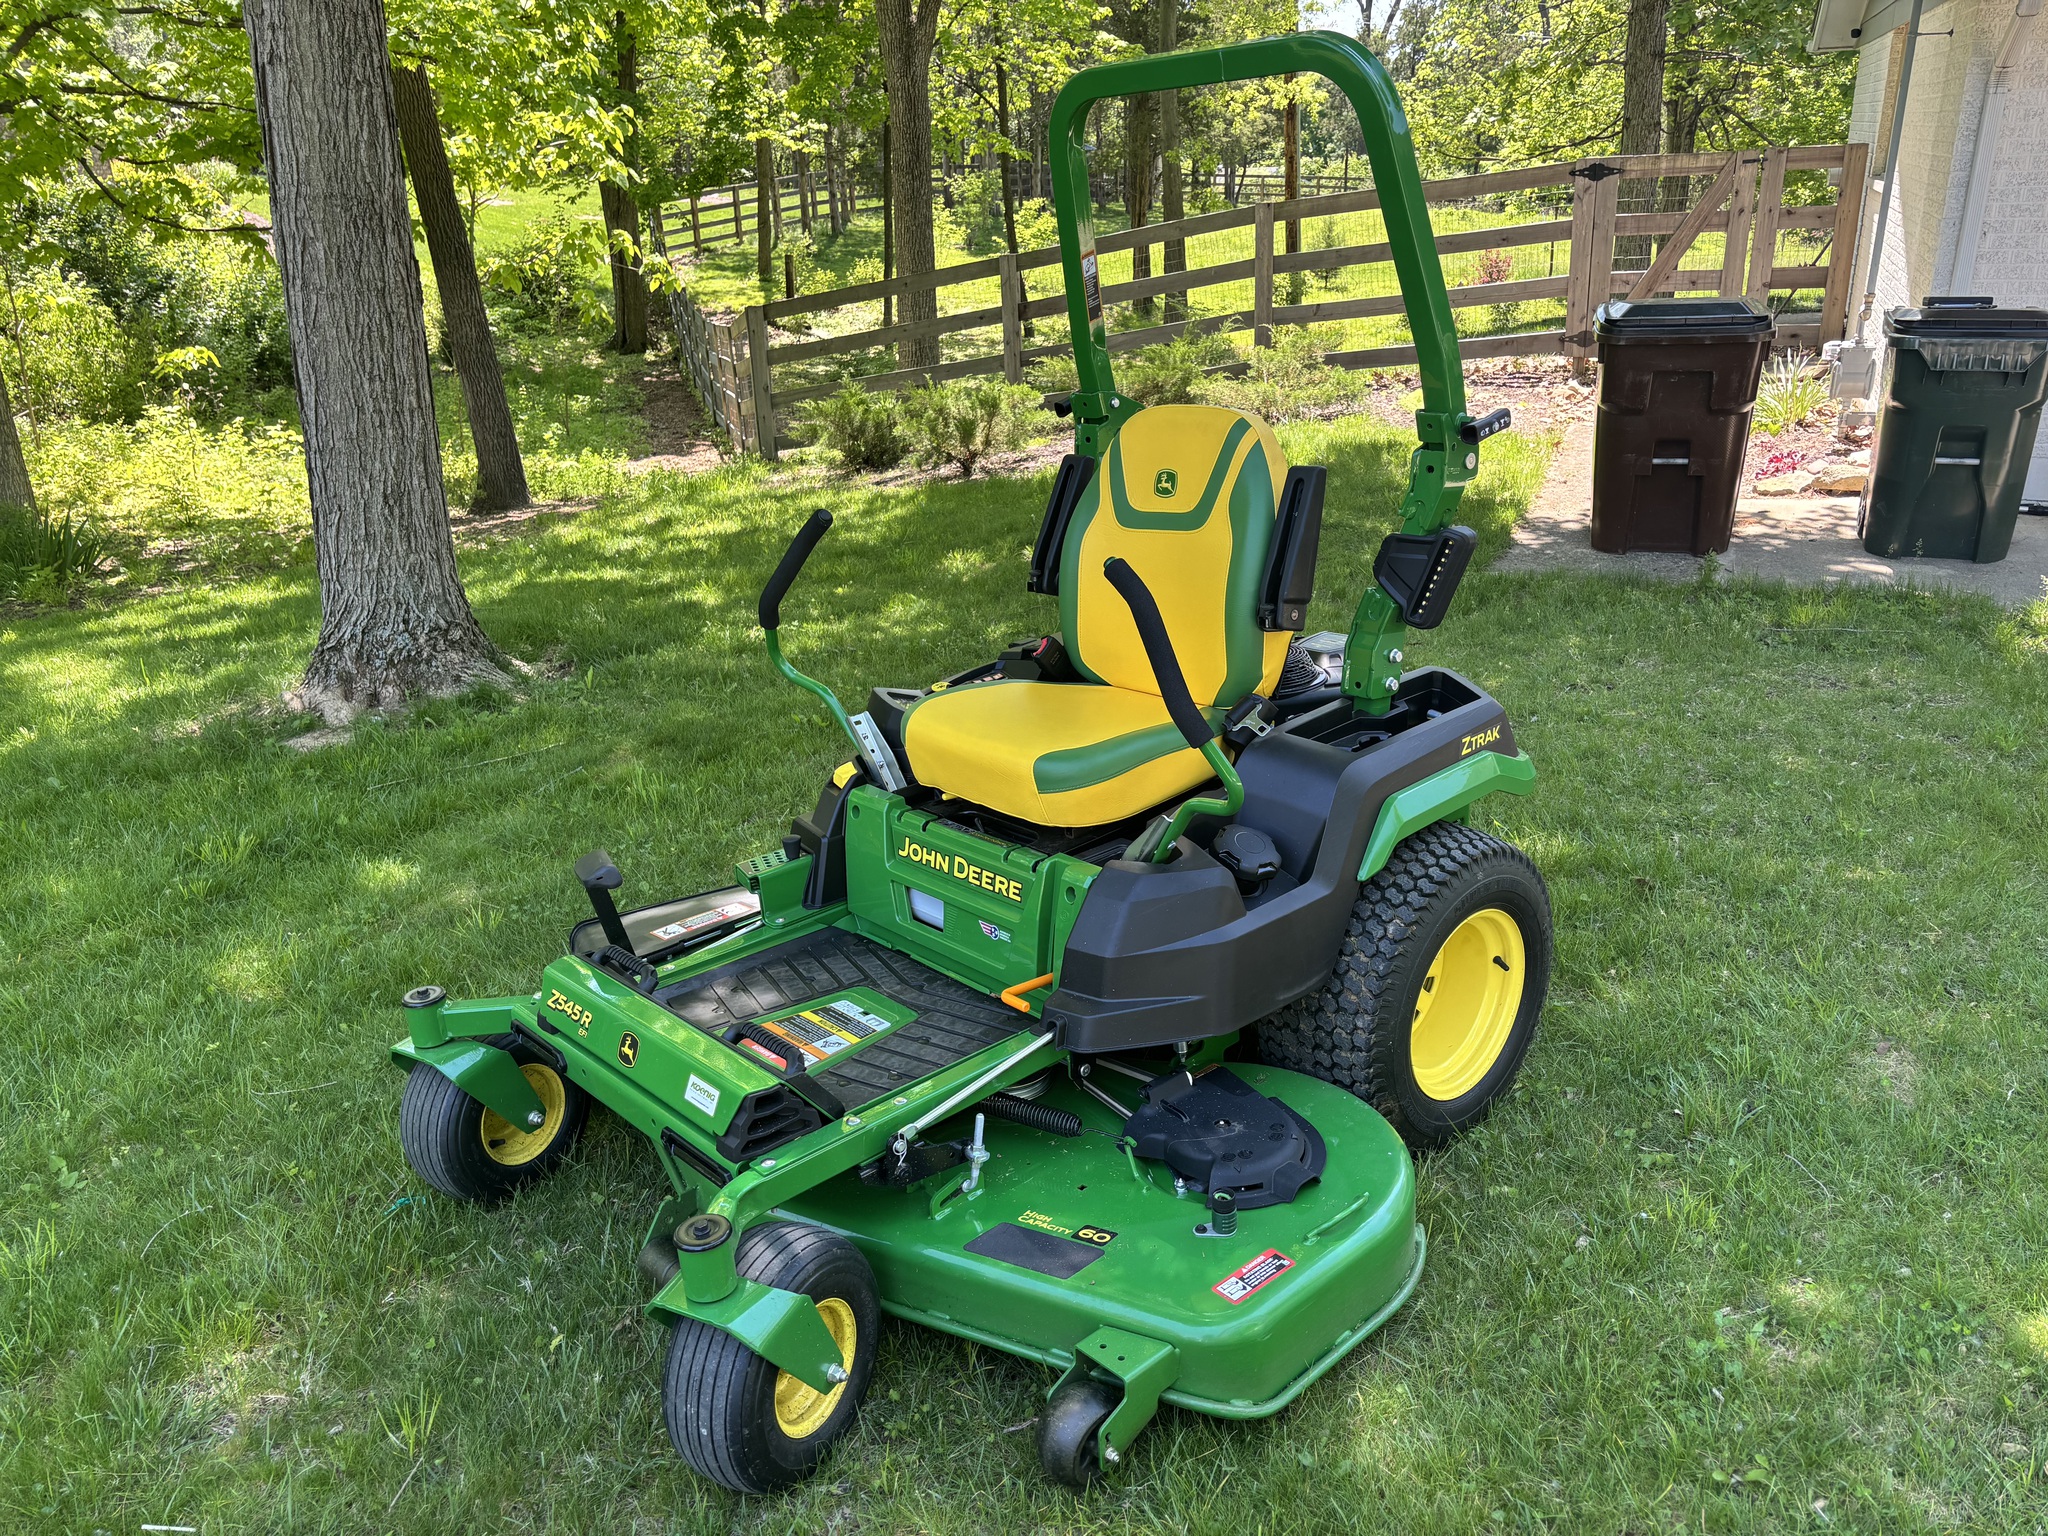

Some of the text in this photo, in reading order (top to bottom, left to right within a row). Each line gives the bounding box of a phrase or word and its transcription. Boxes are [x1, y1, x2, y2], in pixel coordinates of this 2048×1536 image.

[1461, 724, 1500, 756] ZTRAK
[898, 836, 1022, 902] JOHN DEERE
[1023, 1209, 1053, 1222] HIGH
[1018, 1216, 1111, 1243] CAPACITY 60
[1244, 1254, 1266, 1270] DANGER
